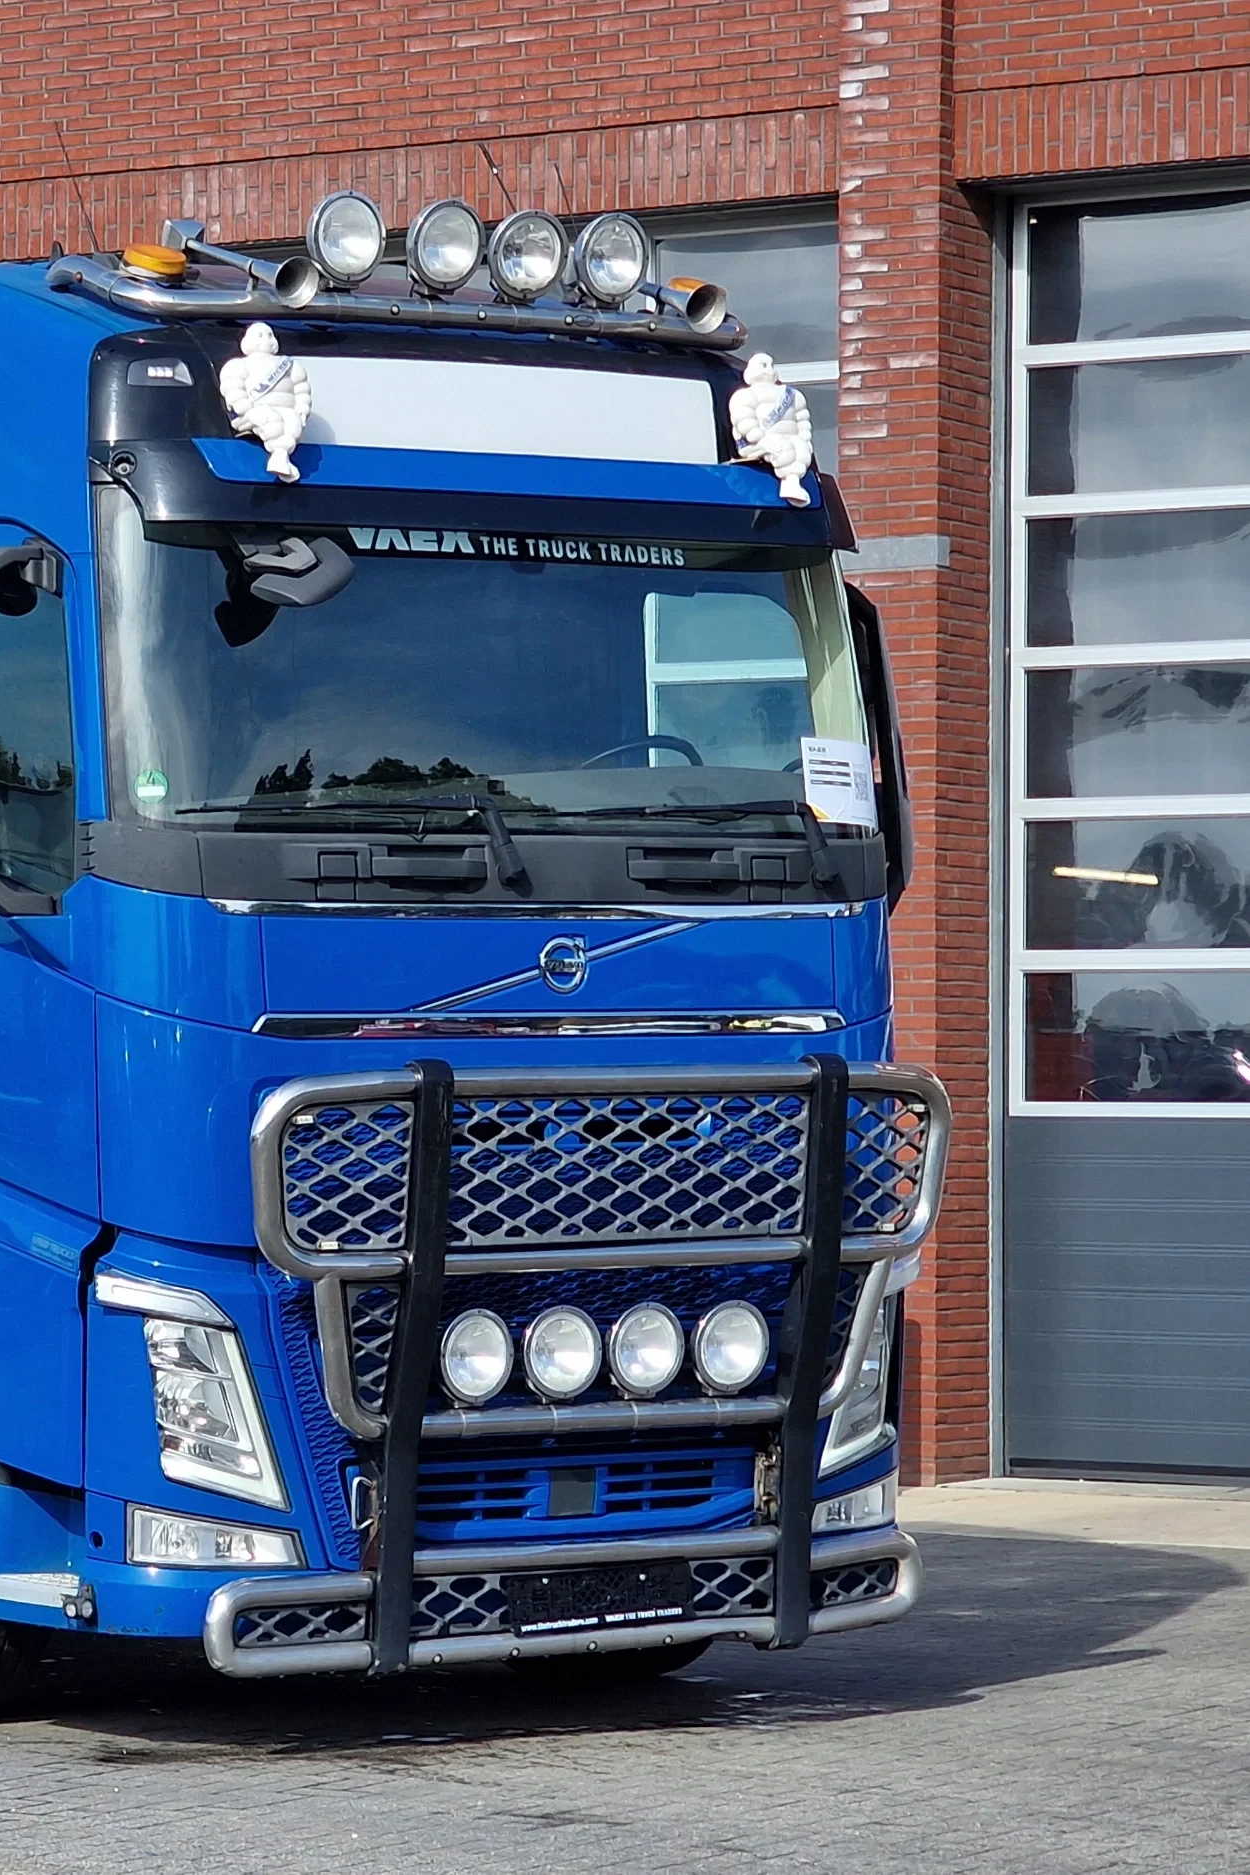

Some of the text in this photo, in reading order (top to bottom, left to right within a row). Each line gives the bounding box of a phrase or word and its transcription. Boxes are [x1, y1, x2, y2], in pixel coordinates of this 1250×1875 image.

[348, 527, 686, 567] VAEX THE TRUCK TRADERS
[146, 771, 155, 786] 4
